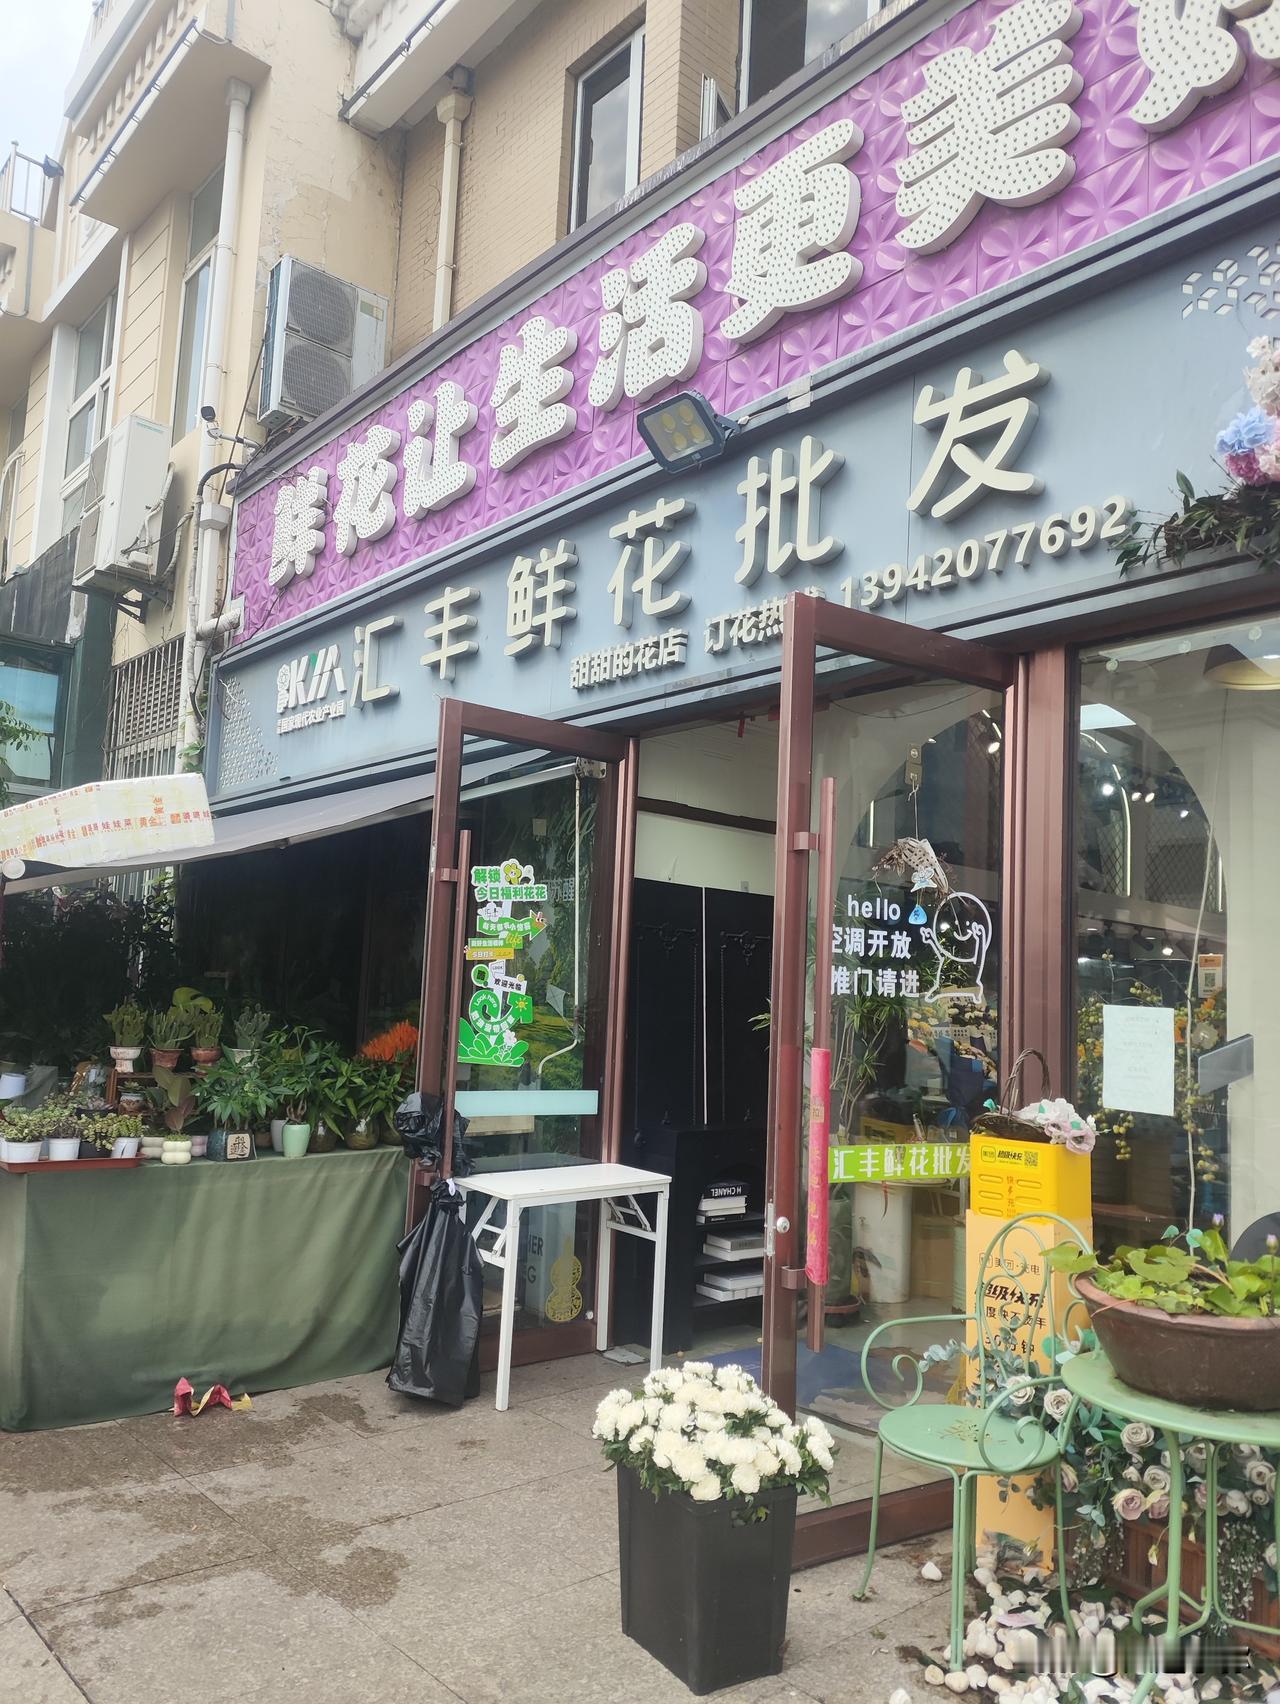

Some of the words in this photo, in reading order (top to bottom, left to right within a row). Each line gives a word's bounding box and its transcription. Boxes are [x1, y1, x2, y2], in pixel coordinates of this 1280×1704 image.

[350, 350, 1051, 710] 汇丰鲜花批发
[570, 628, 688, 690] 甜甜的花店
[704, 586, 827, 654] 订花热
[840, 495, 1133, 609] 13942077692
[475, 885, 547, 901] 今日福利花花
[847, 894, 901, 921] hello
[832, 924, 911, 959] 空调开放
[494, 978, 522, 991] 欢迎光临
[831, 965, 920, 998] 推门请进
[834, 1143, 970, 1180] 汇丰鲜花批发
[711, 1187, 735, 1196] CHANEL
